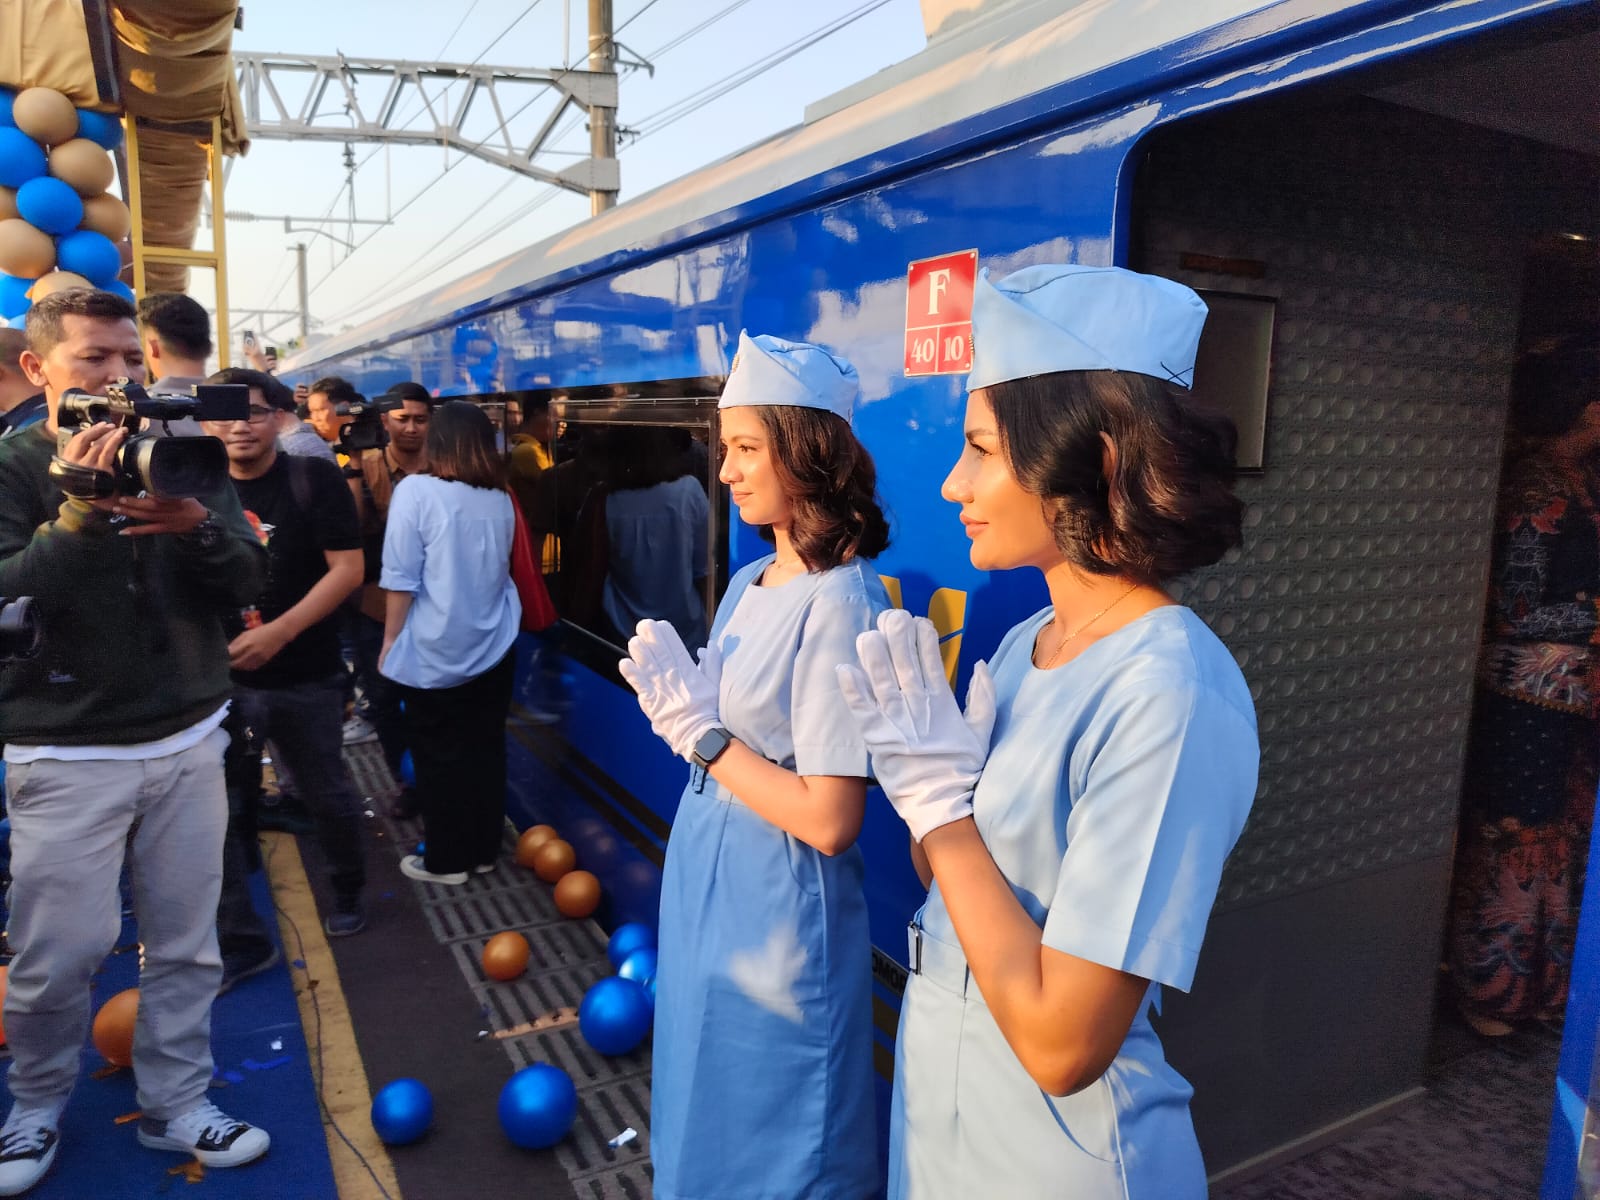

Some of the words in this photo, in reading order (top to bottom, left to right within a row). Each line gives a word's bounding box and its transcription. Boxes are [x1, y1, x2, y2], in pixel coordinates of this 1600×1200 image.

[928, 268, 951, 315] F
[911, 337, 935, 363] 40
[943, 335, 965, 362] 10
